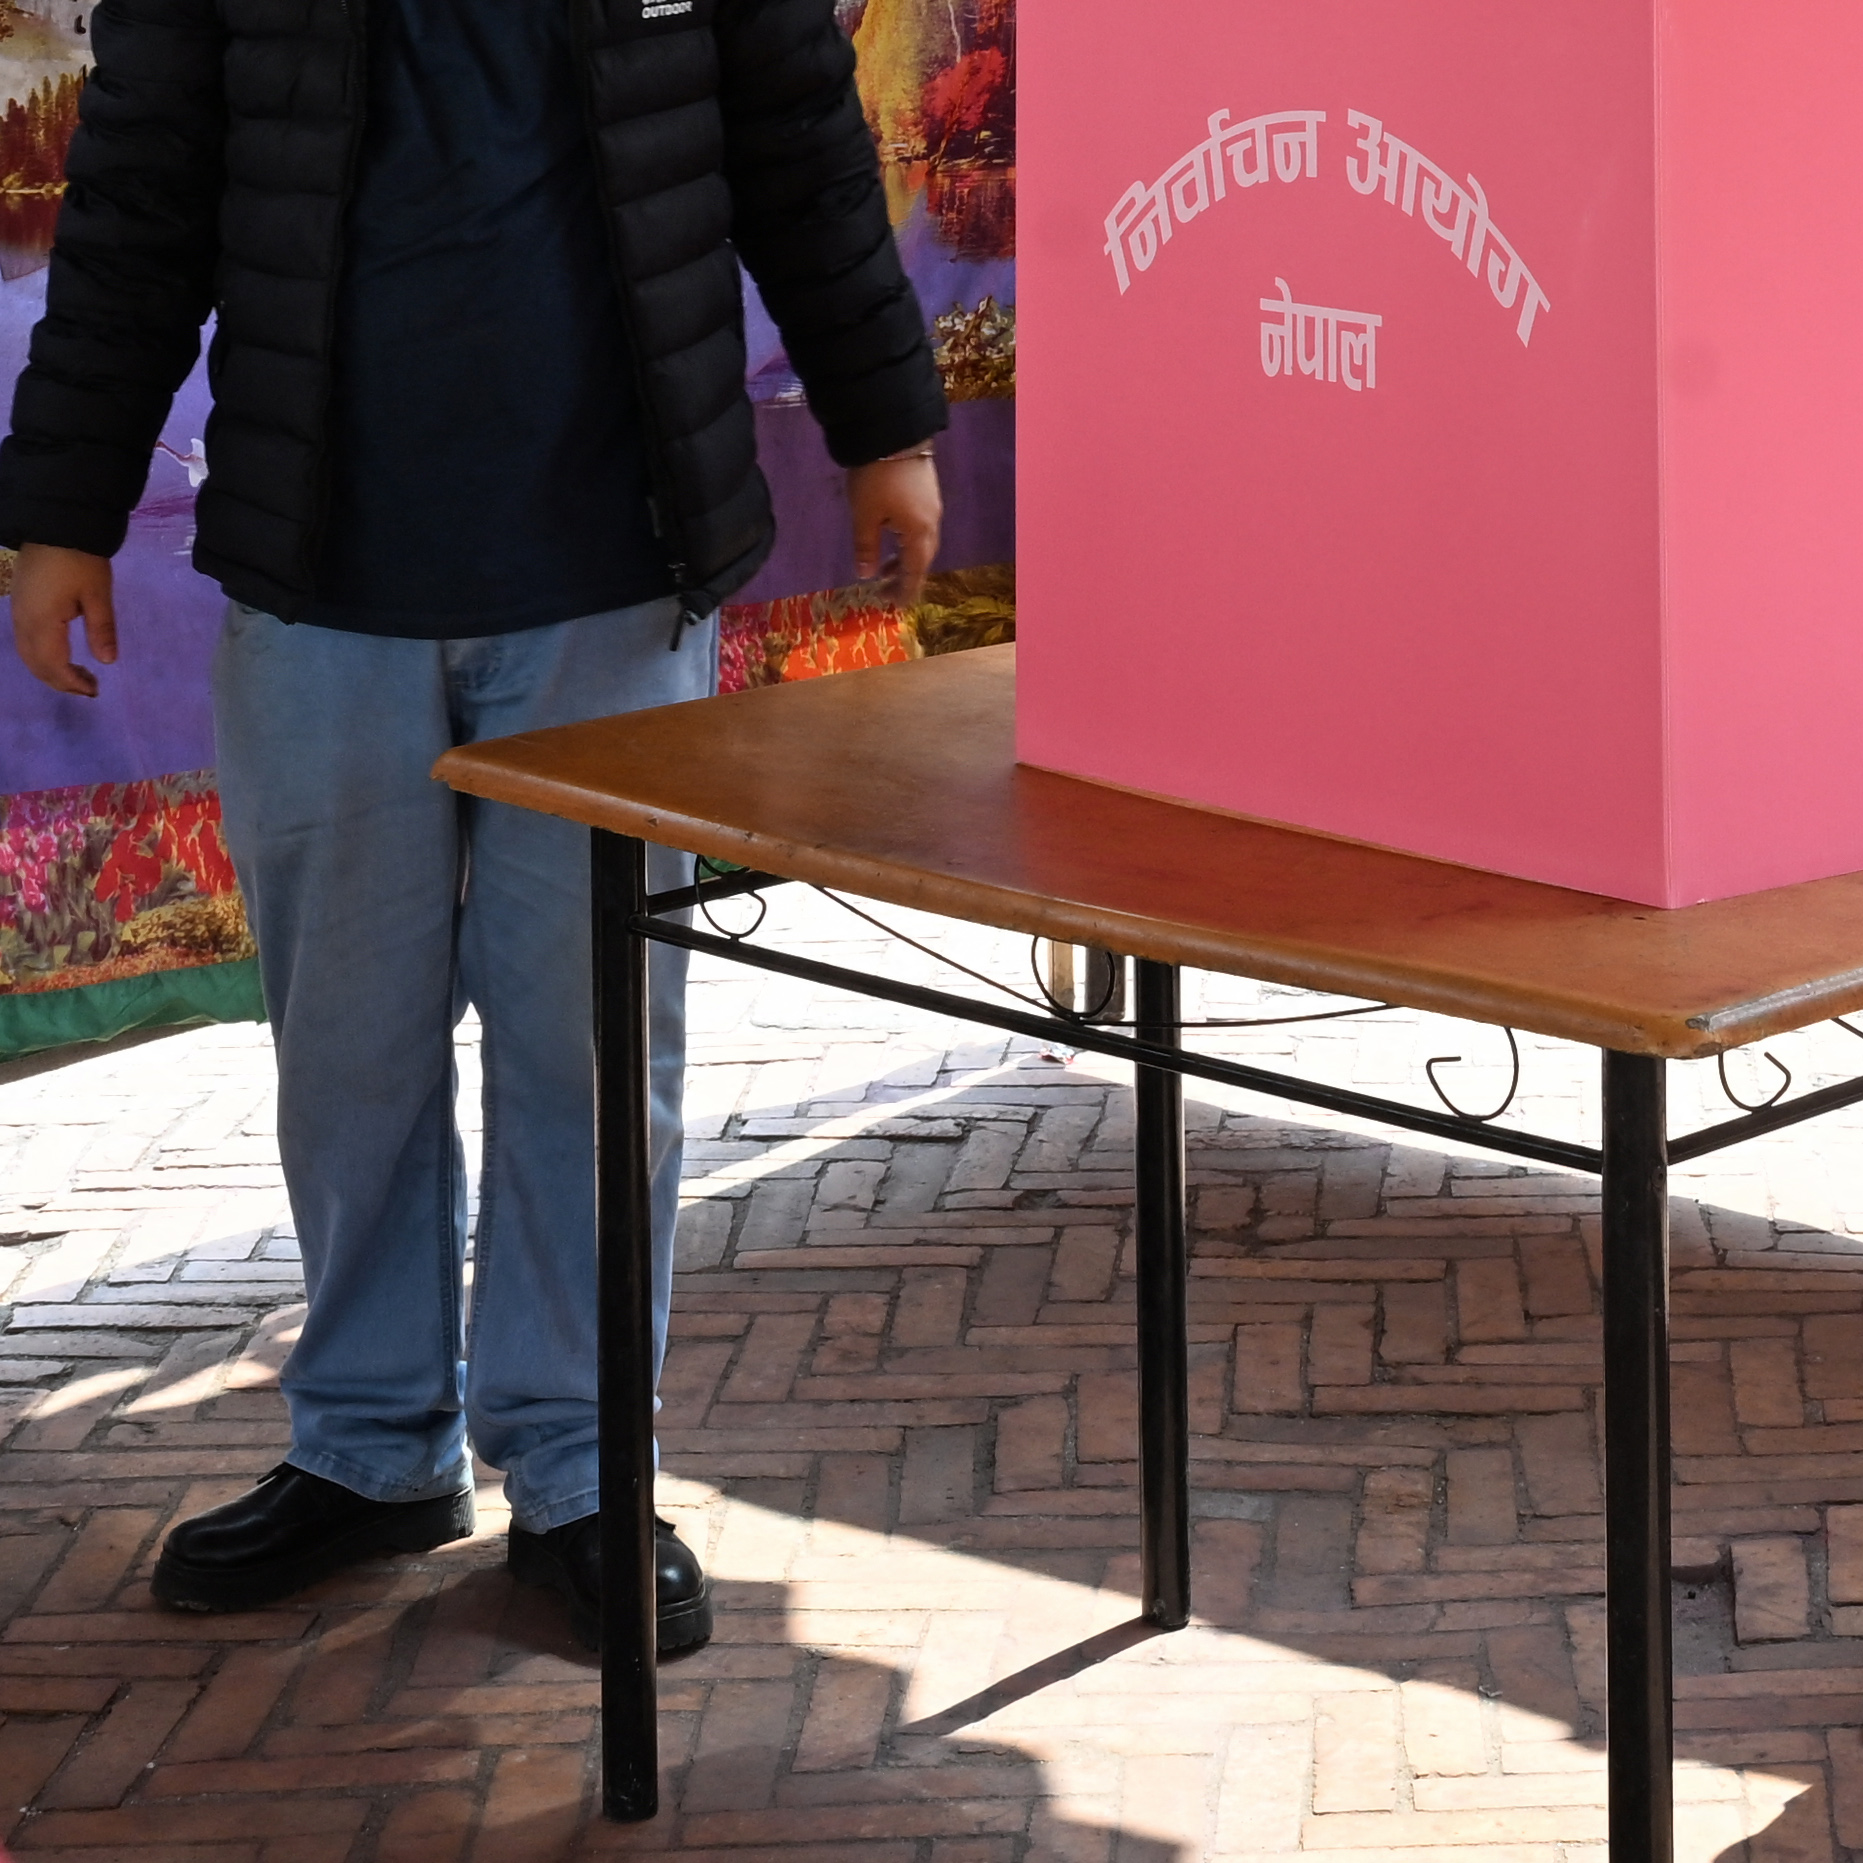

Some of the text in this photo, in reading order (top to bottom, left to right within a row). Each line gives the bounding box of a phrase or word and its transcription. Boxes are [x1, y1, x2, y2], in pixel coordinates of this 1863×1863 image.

[641, 0, 693, 19] OUTDOOR
[1103, 108, 1551, 348] निर्वाचन आयोग
[1260, 276, 1382, 392] नेपाल
